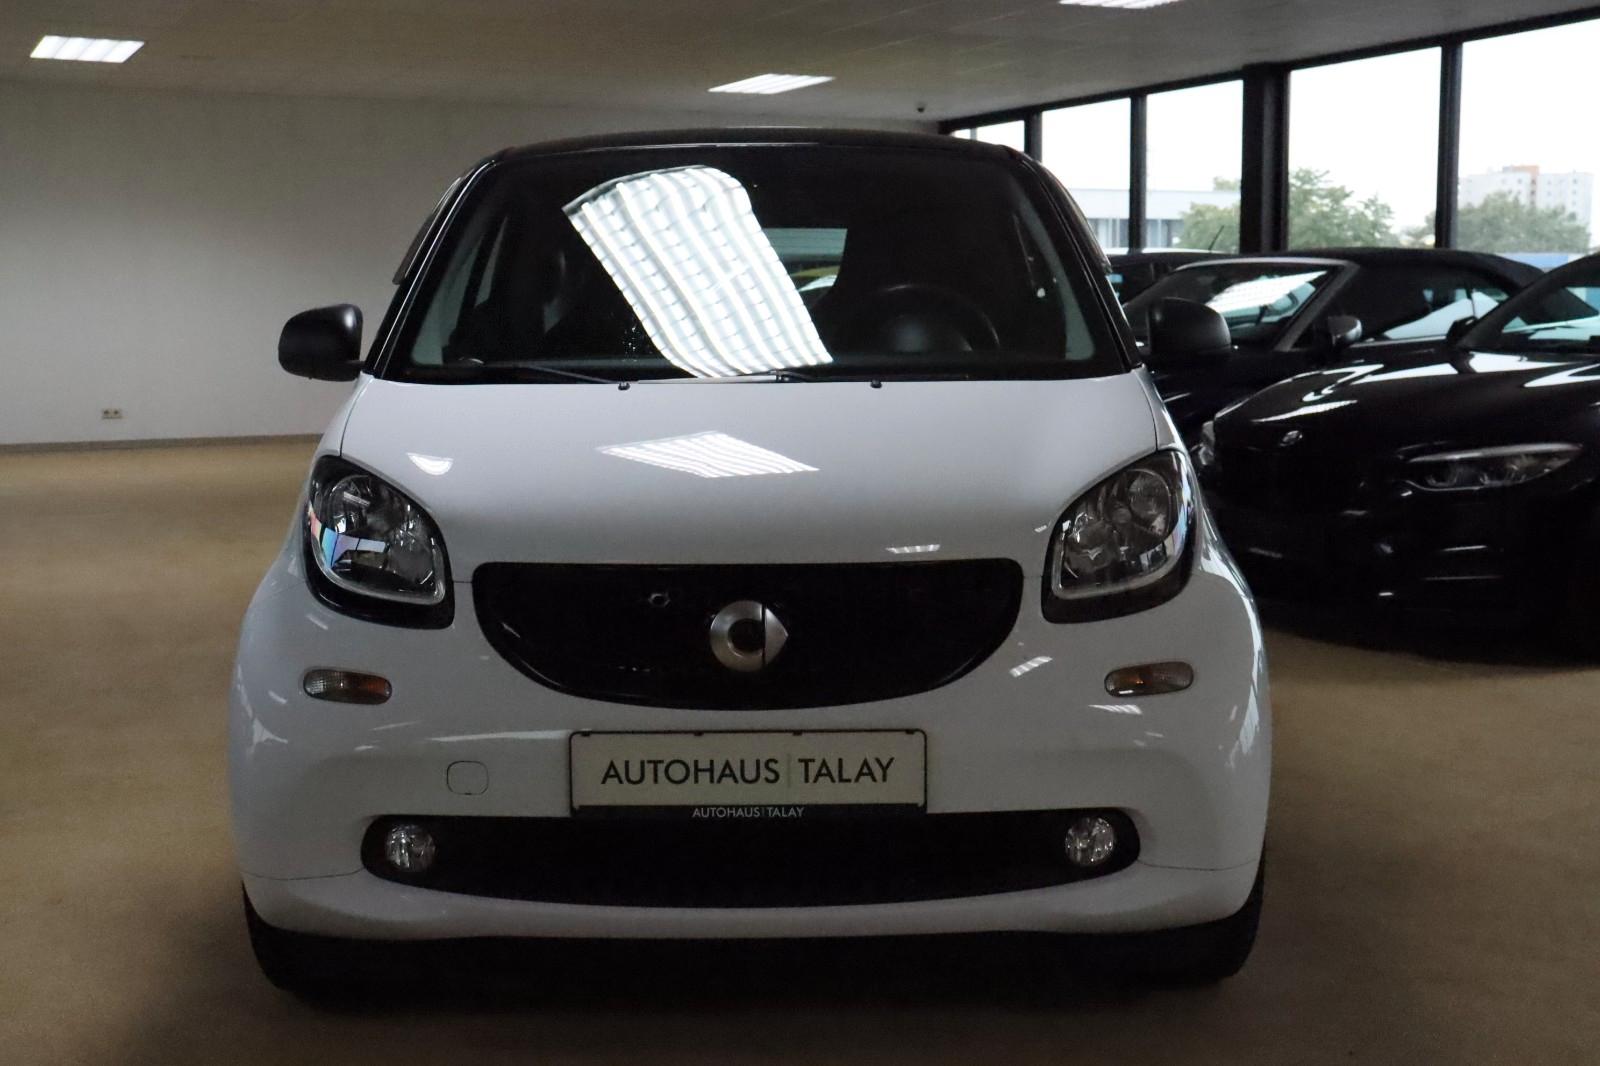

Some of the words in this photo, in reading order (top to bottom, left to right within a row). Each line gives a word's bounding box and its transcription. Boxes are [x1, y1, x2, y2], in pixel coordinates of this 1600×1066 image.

[600, 758, 780, 785] AUTOHAUS
[798, 757, 896, 784] TALAY
[691, 806, 761, 818] AUTOHAUS
[766, 806, 805, 818] TALAY
